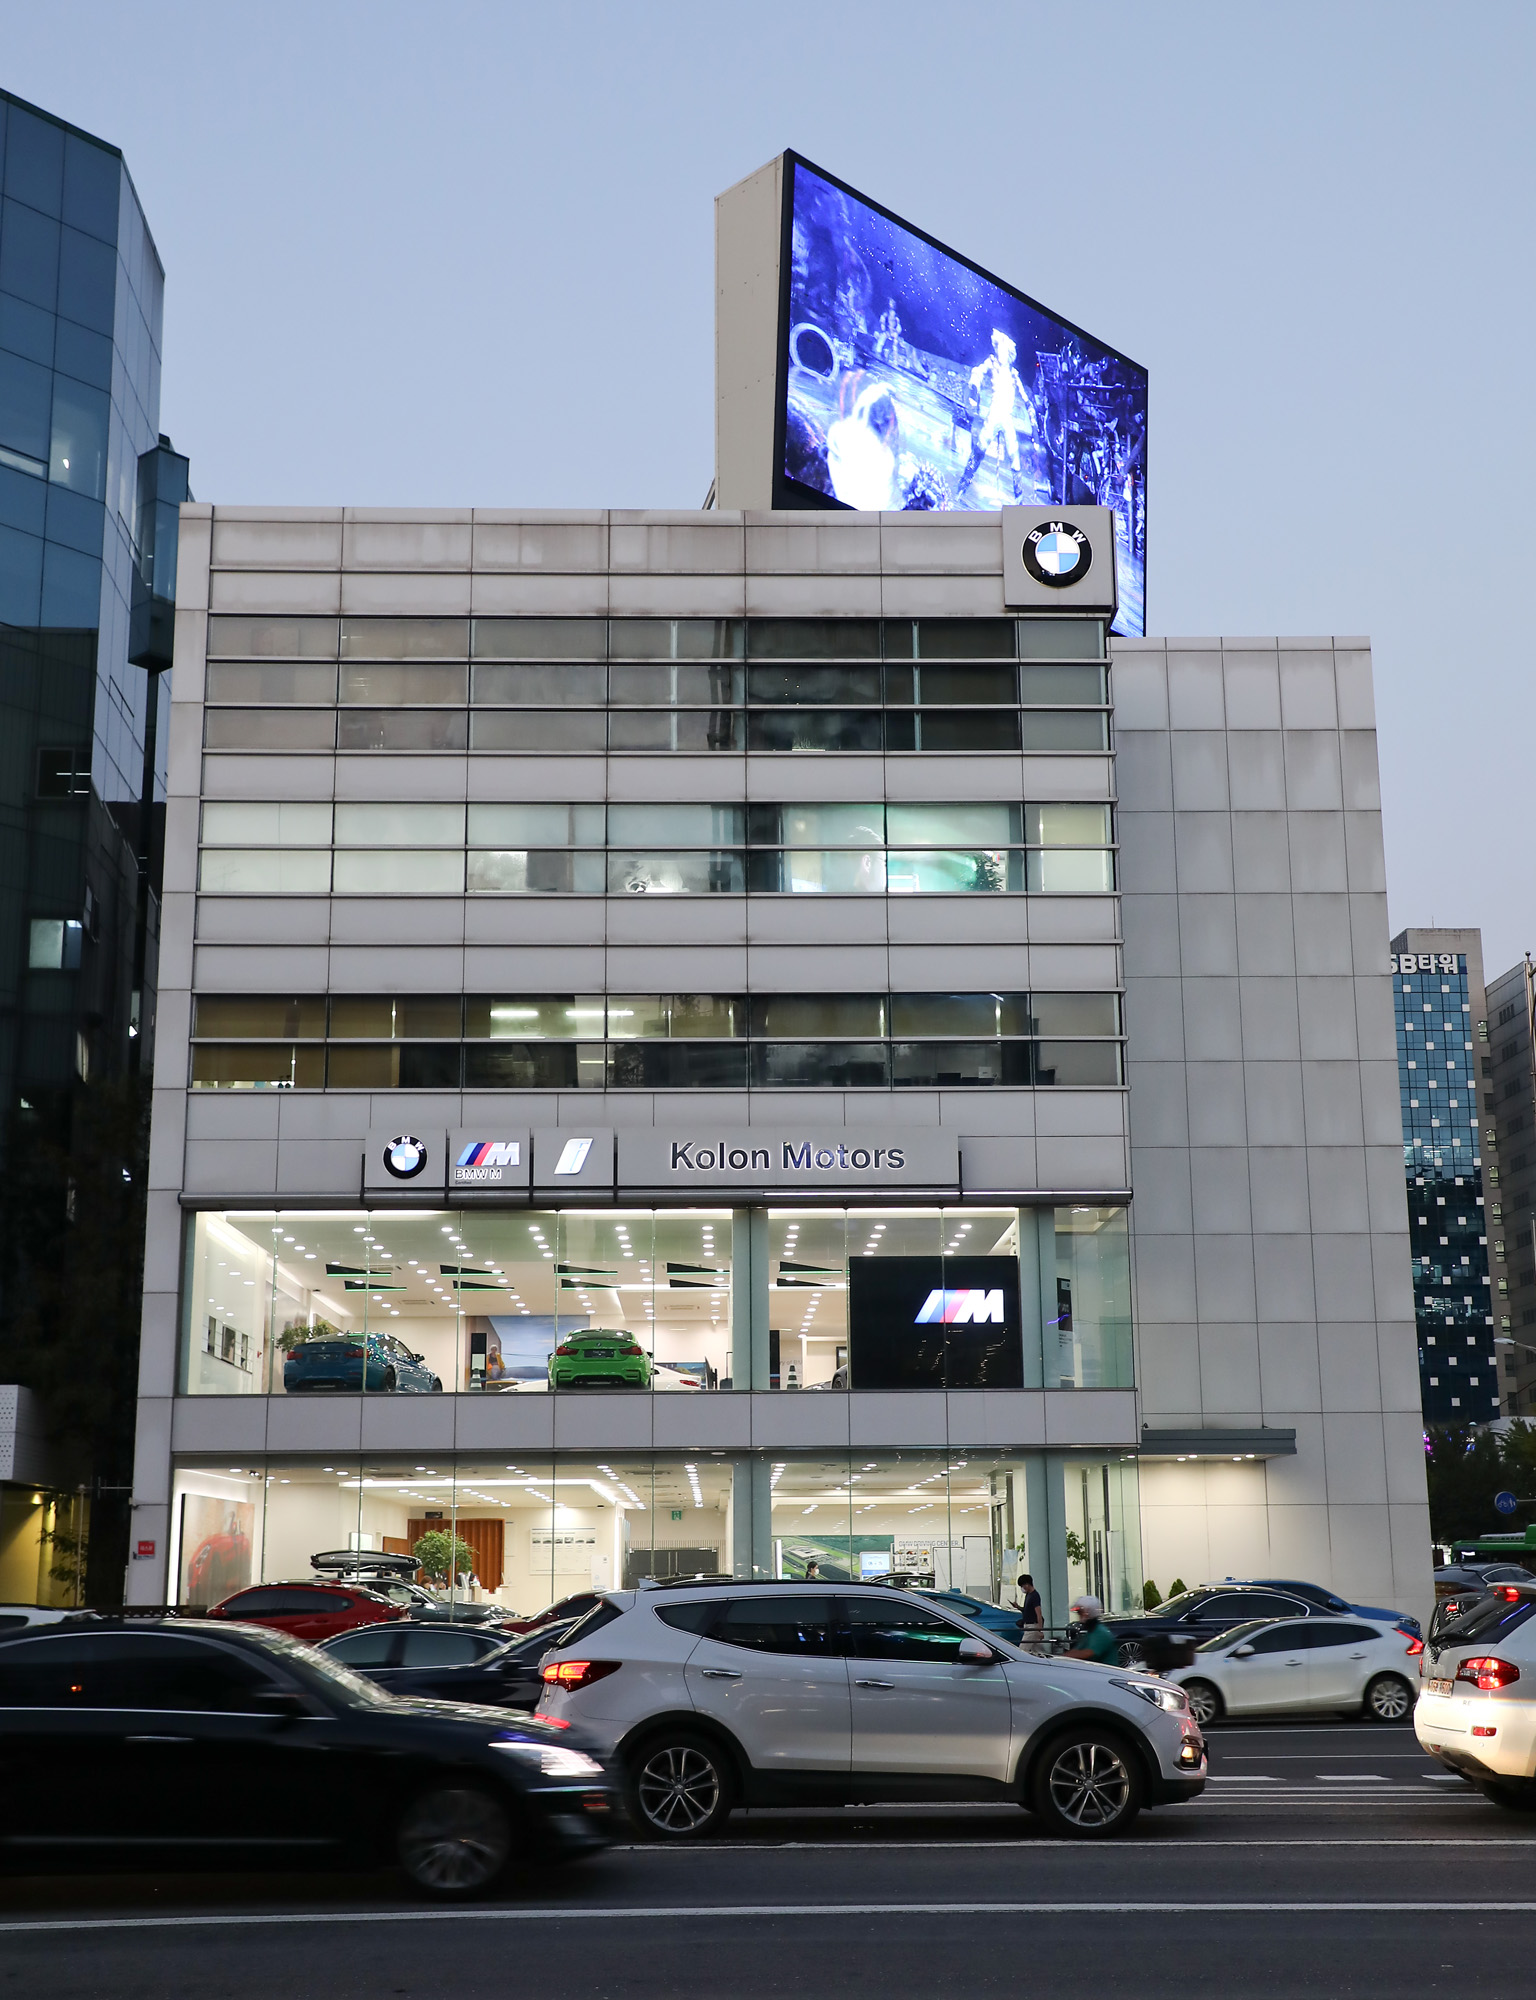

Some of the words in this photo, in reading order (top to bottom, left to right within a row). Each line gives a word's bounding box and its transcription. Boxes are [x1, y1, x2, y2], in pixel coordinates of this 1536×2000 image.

[1028, 522, 1087, 543] BMW
[387, 1136, 425, 1150] BMW
[671, 1142, 770, 1170] Kolon
[782, 1141, 905, 1170] Motors
[455, 1168, 488, 1179] BMW
[490, 1168, 502, 1179] M
